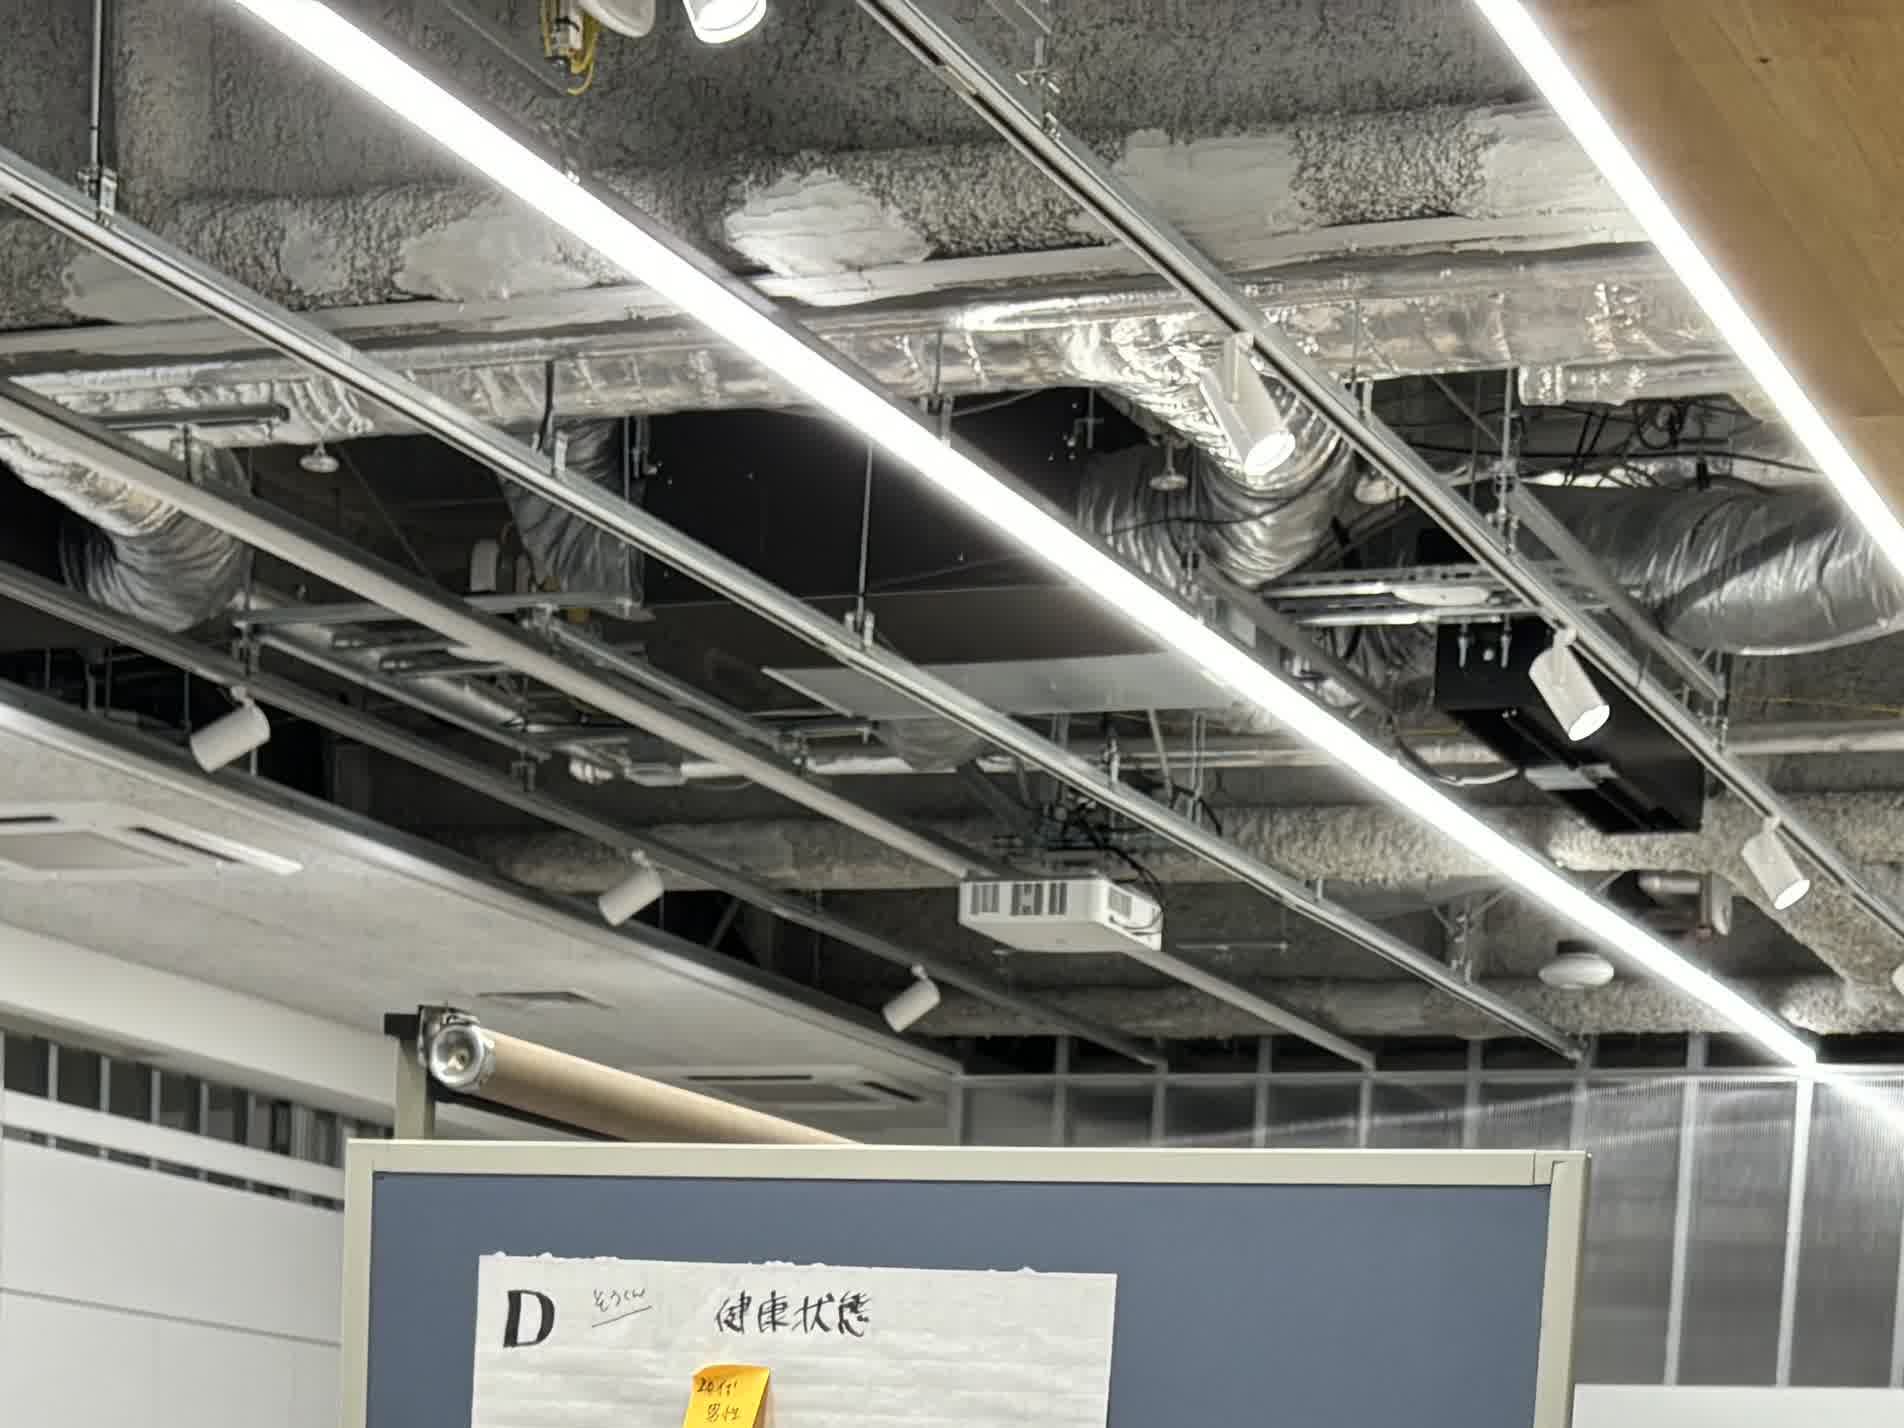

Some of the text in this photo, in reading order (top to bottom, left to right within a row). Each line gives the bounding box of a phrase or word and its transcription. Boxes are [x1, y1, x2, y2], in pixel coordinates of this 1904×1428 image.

[503, 1289, 556, 1348] D
[714, 1289, 872, 1338] 健康状態
[705, 1402, 742, 1423] 男性
